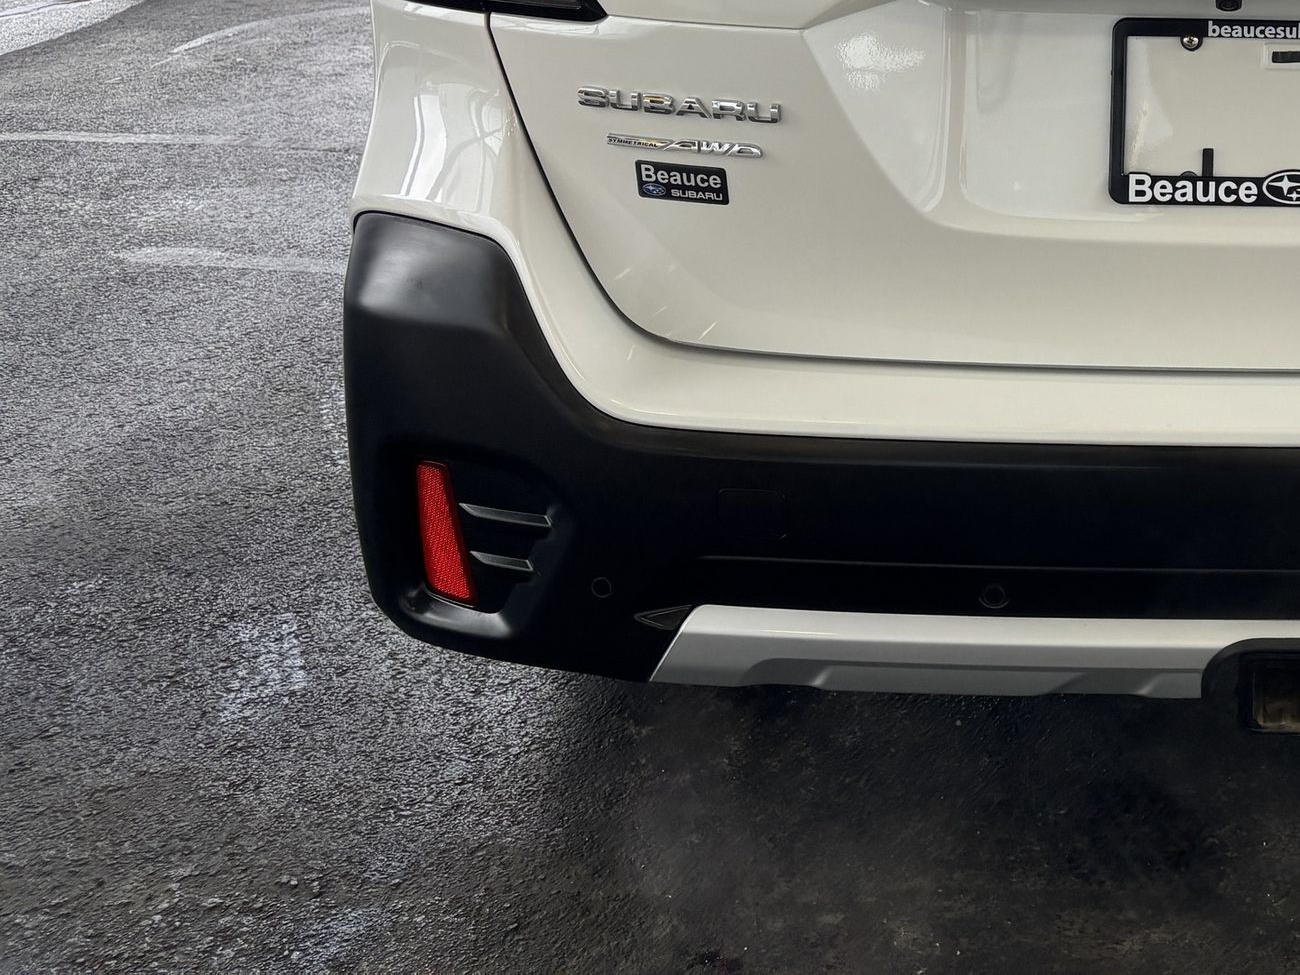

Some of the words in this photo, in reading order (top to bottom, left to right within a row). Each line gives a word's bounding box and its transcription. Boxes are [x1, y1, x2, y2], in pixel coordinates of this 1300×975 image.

[577, 85, 783, 123] SUBARU
[662, 138, 763, 159] AWD
[640, 163, 723, 189] Beauce
[1127, 173, 1259, 204] Beauce
[670, 188, 723, 201] SUBARU
